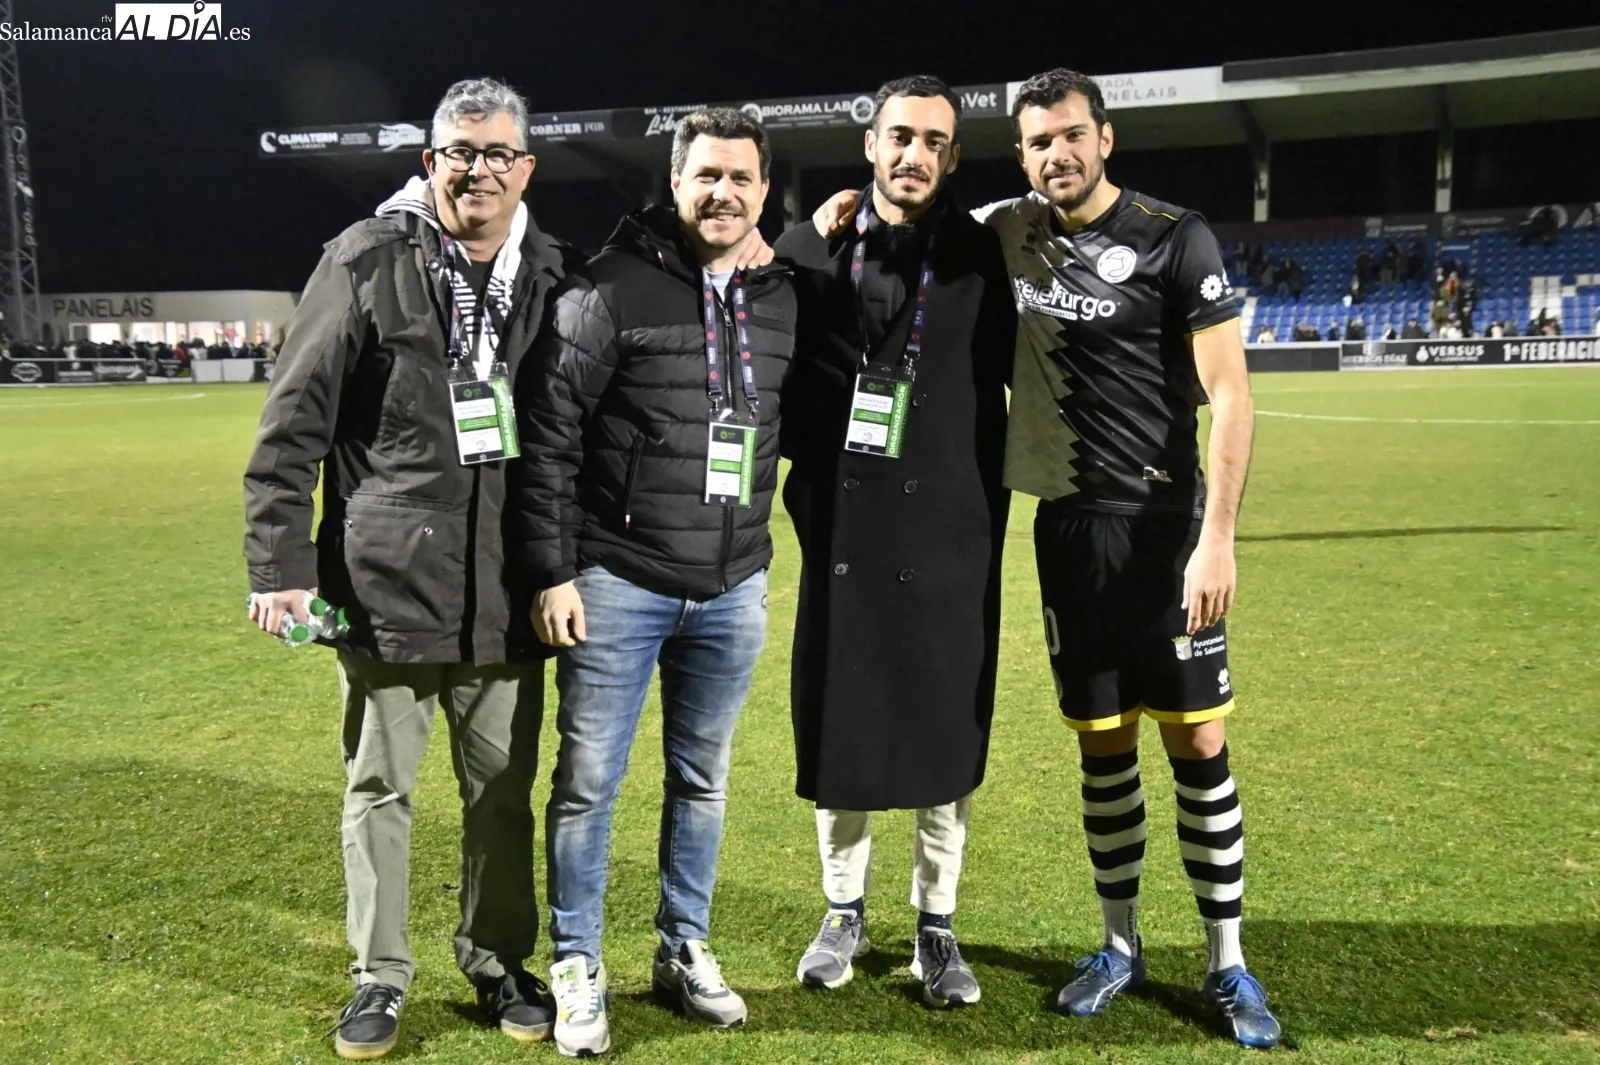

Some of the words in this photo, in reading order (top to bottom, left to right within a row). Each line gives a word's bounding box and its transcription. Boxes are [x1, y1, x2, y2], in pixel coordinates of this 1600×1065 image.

[1107, 84, 1177, 101] NELAIS
[762, 102, 822, 117] BIORAMA
[824, 100, 852, 113] LAB
[529, 122, 582, 136] CORNER
[1014, 276, 1117, 321] telefurgo
[53, 297, 154, 318] PANELAIS
[1428, 345, 1485, 357] VERSUS
[889, 385, 906, 455] ORGANIZACIÓN
[1194, 649, 1203, 657] de
